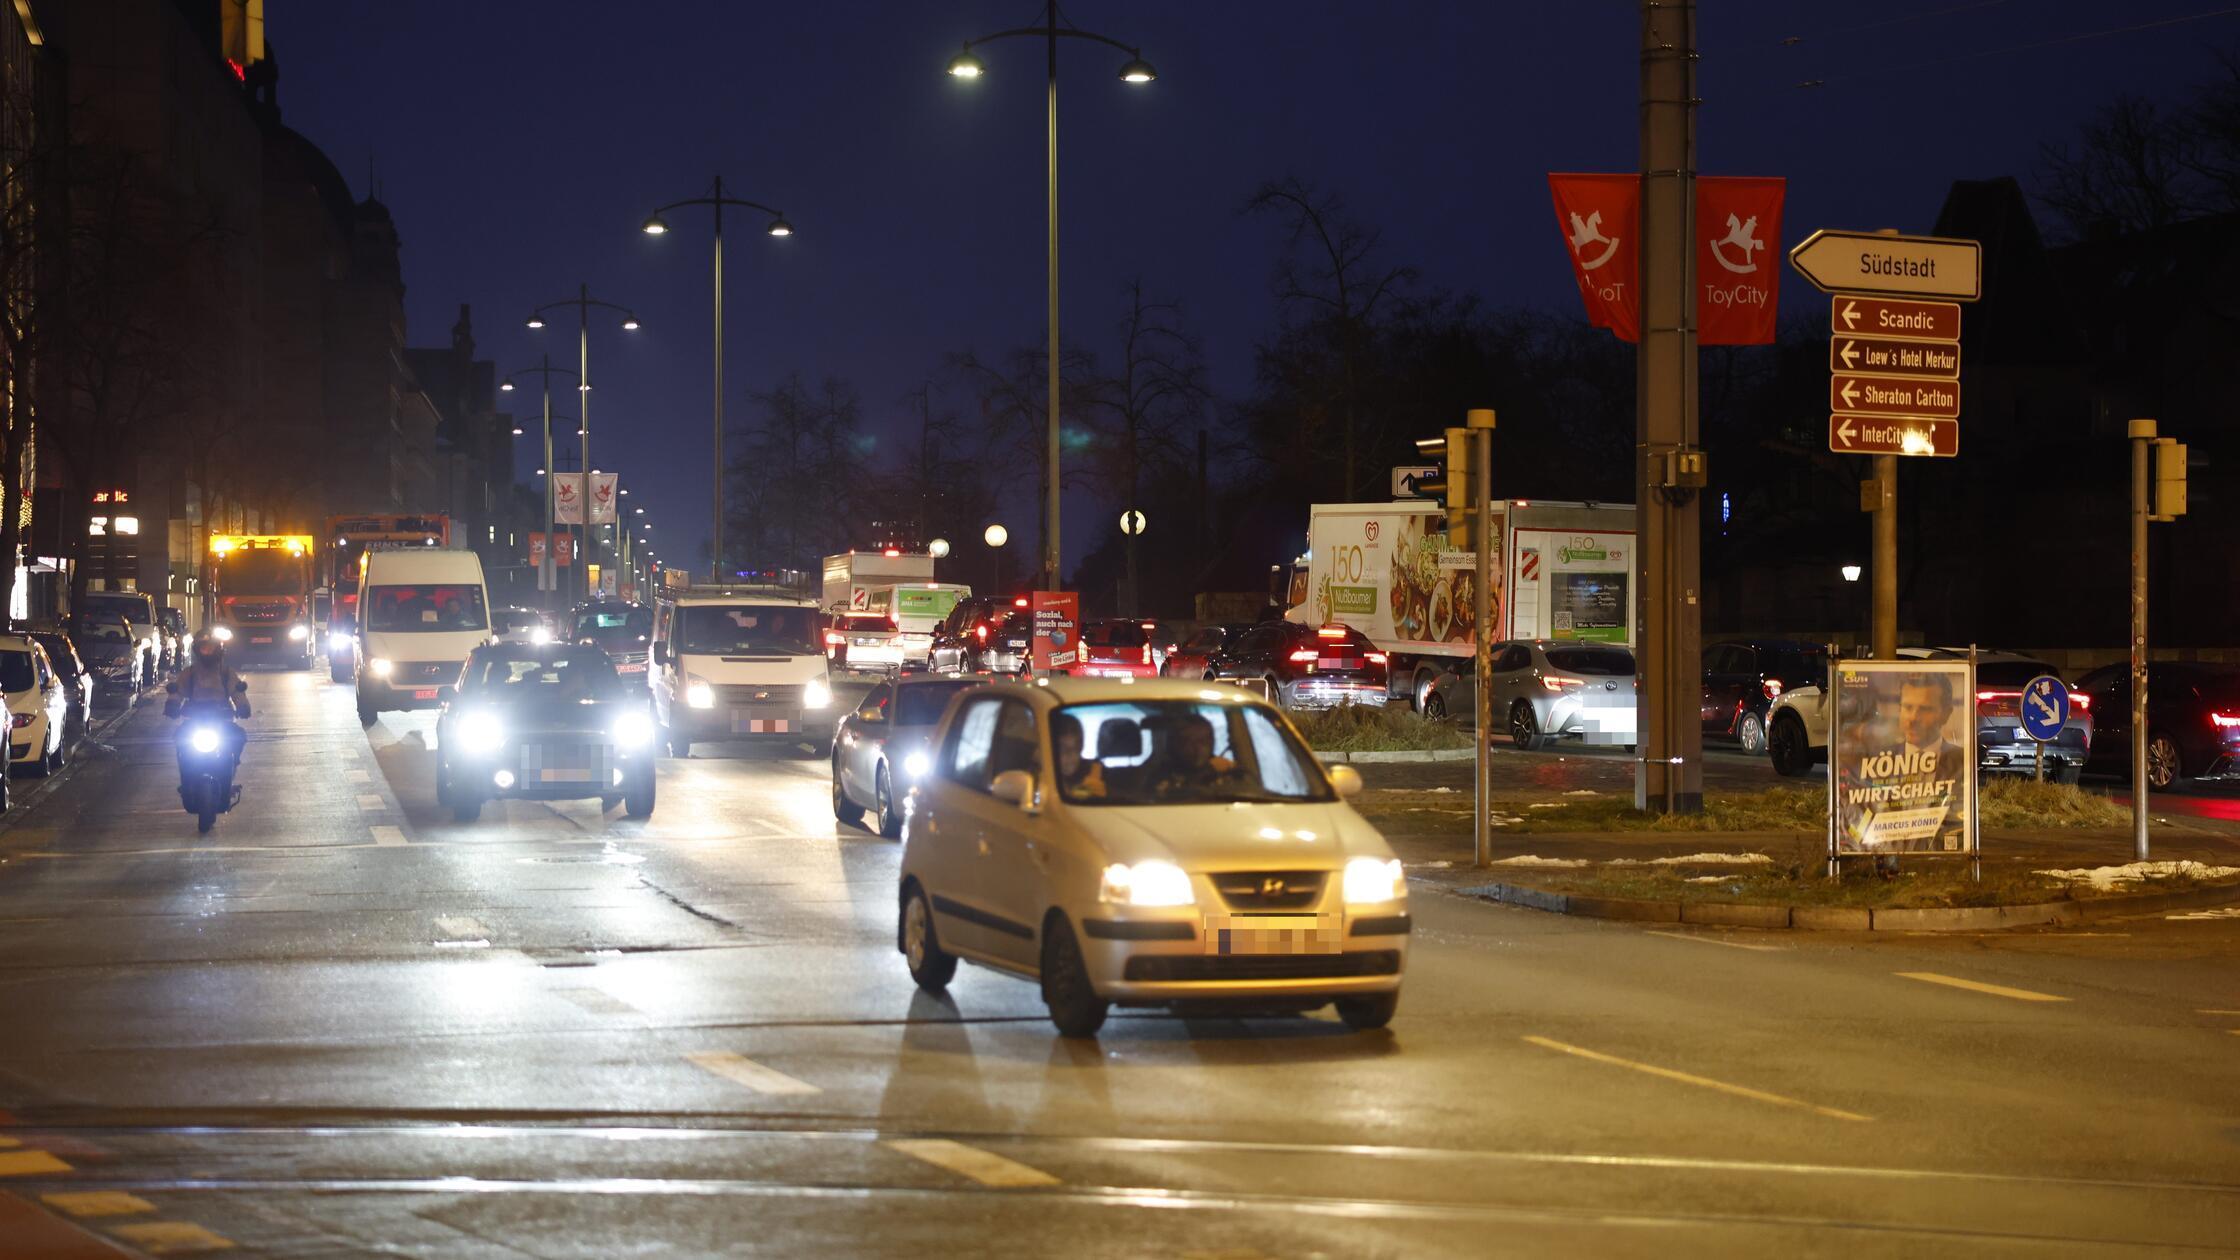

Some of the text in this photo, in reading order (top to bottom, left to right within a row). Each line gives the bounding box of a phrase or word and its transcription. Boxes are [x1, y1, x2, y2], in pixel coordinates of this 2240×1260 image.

[1860, 253, 1936, 278] Südstadt
[1705, 284, 1768, 308] ToyCity
[1879, 309, 1934, 330] Scandic
[1900, 350, 1922, 367] Hotel
[1925, 351, 1955, 369] Merkur
[1865, 386, 1953, 407] Sheraton Carlton
[1568, 536, 1594, 550] 150
[1331, 544, 1363, 583] 150
[1036, 611, 1063, 619] Sozial,
[1036, 620, 1056, 628] auch
[1036, 629, 1051, 637] der
[1860, 751, 1936, 780] KÖNIG
[1848, 779, 1956, 805] WIRTSCHAFT
[1873, 816, 1938, 832] MARCUS KÖNIG
